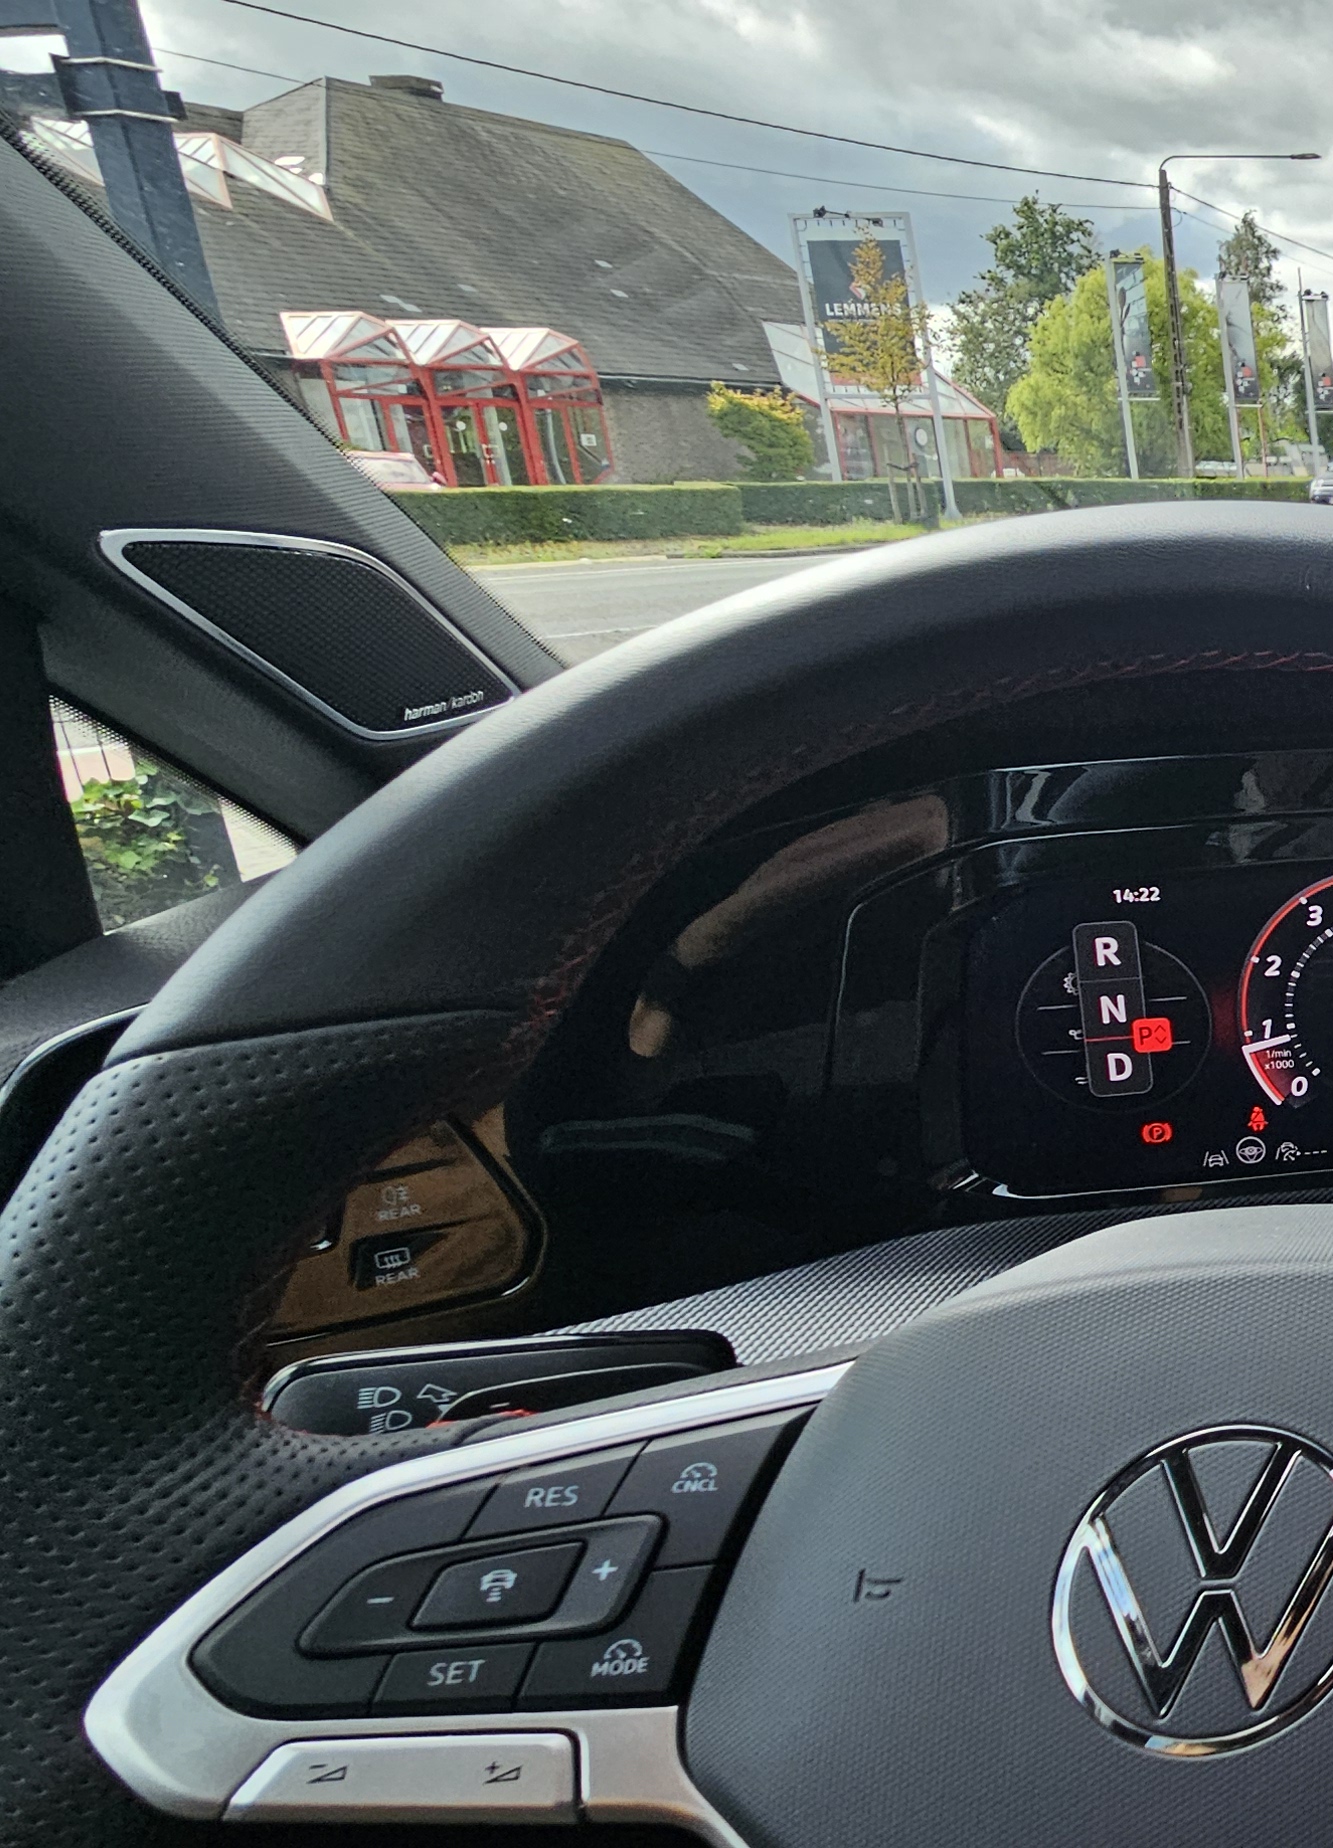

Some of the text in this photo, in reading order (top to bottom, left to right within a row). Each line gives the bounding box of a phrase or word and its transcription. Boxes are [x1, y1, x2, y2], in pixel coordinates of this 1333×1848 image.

[825, 302, 902, 317] LEMMENS
[1113, 886, 1162, 904] 14:22
[1306, 904, 1324, 927] 3
[1093, 936, 1122, 967] R
[1263, 954, 1283, 978] 2
[1099, 994, 1128, 1025] N
[1138, 1026, 1152, 1046] P
[1262, 1018, 1273, 1040] 1
[1263, 1059, 1295, 1071] x1000
[1265, 1050, 1292, 1059] 1/min
[1106, 1053, 1134, 1083] D
[1290, 1076, 1309, 1097] 0
[377, 1203, 422, 1222] REAR
[374, 1267, 420, 1287] REAR
[671, 1476, 719, 1494] CNCL
[524, 1485, 579, 1509] RES
[426, 1658, 486, 1687] SET
[590, 1654, 651, 1677] MODE
